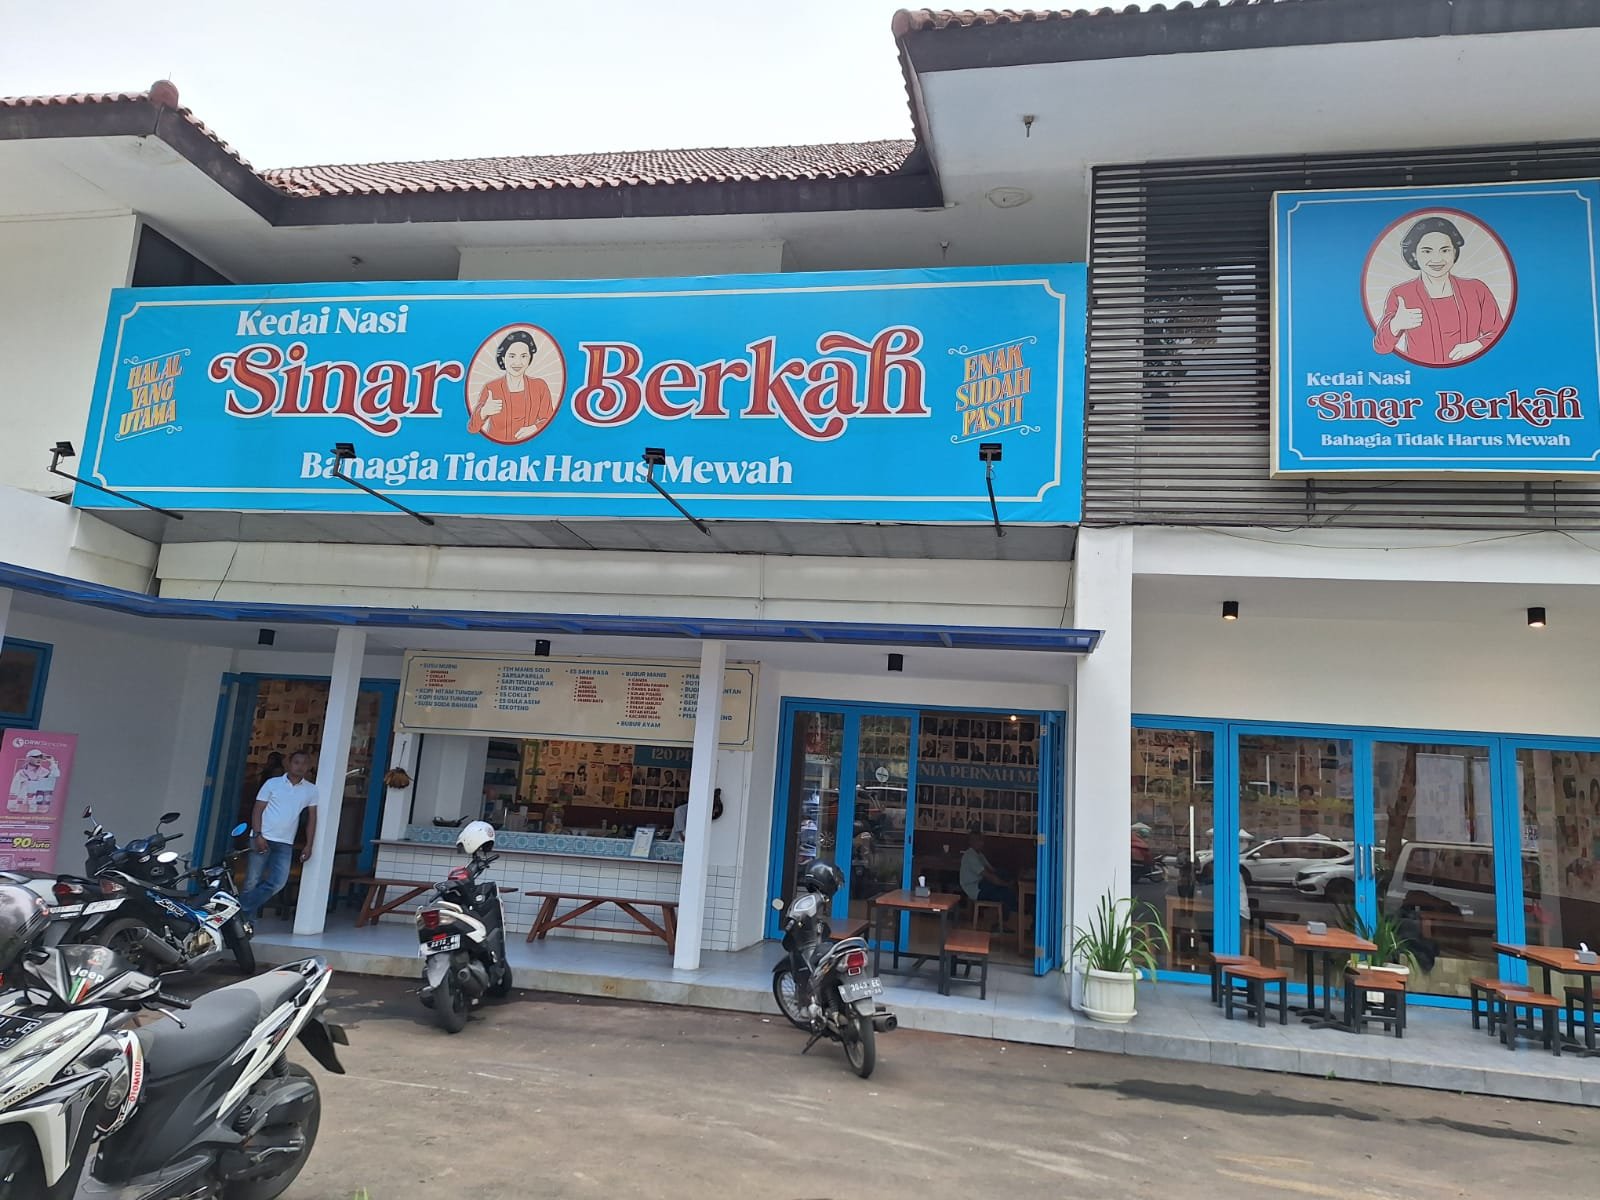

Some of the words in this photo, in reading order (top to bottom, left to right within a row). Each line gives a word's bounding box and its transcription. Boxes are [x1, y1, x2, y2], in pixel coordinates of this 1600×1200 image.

[236, 307, 329, 336] Kedai
[335, 305, 408, 334] Nasi
[127, 354, 183, 390] HALAL
[963, 342, 1024, 383] ENAK
[1306, 371, 1364, 387] Kedai
[1368, 370, 1411, 385] Nasi
[131, 378, 176, 411] YANG
[208, 342, 463, 437] Sinar
[571, 325, 931, 442] Berkah
[955, 367, 1031, 412] SUDAH
[119, 399, 177, 436] UTAMA
[962, 396, 1024, 437] PASTI
[1307, 391, 1423, 426] Sinar
[1435, 386, 1584, 428] Berkah
[1321, 433, 1392, 449] Bahagia
[1394, 433, 1444, 446] Tidak
[1447, 433, 1503, 446] Harus
[1506, 433, 1571, 446] Mewah
[443, 453, 542, 482] Tidak
[544, 454, 650, 484] Harus
[661, 454, 793, 485] Mewah
[950, 765, 1015, 782] PERNAH
[13, 837, 32, 848] 90
[70, 965, 105, 984] Jeep
